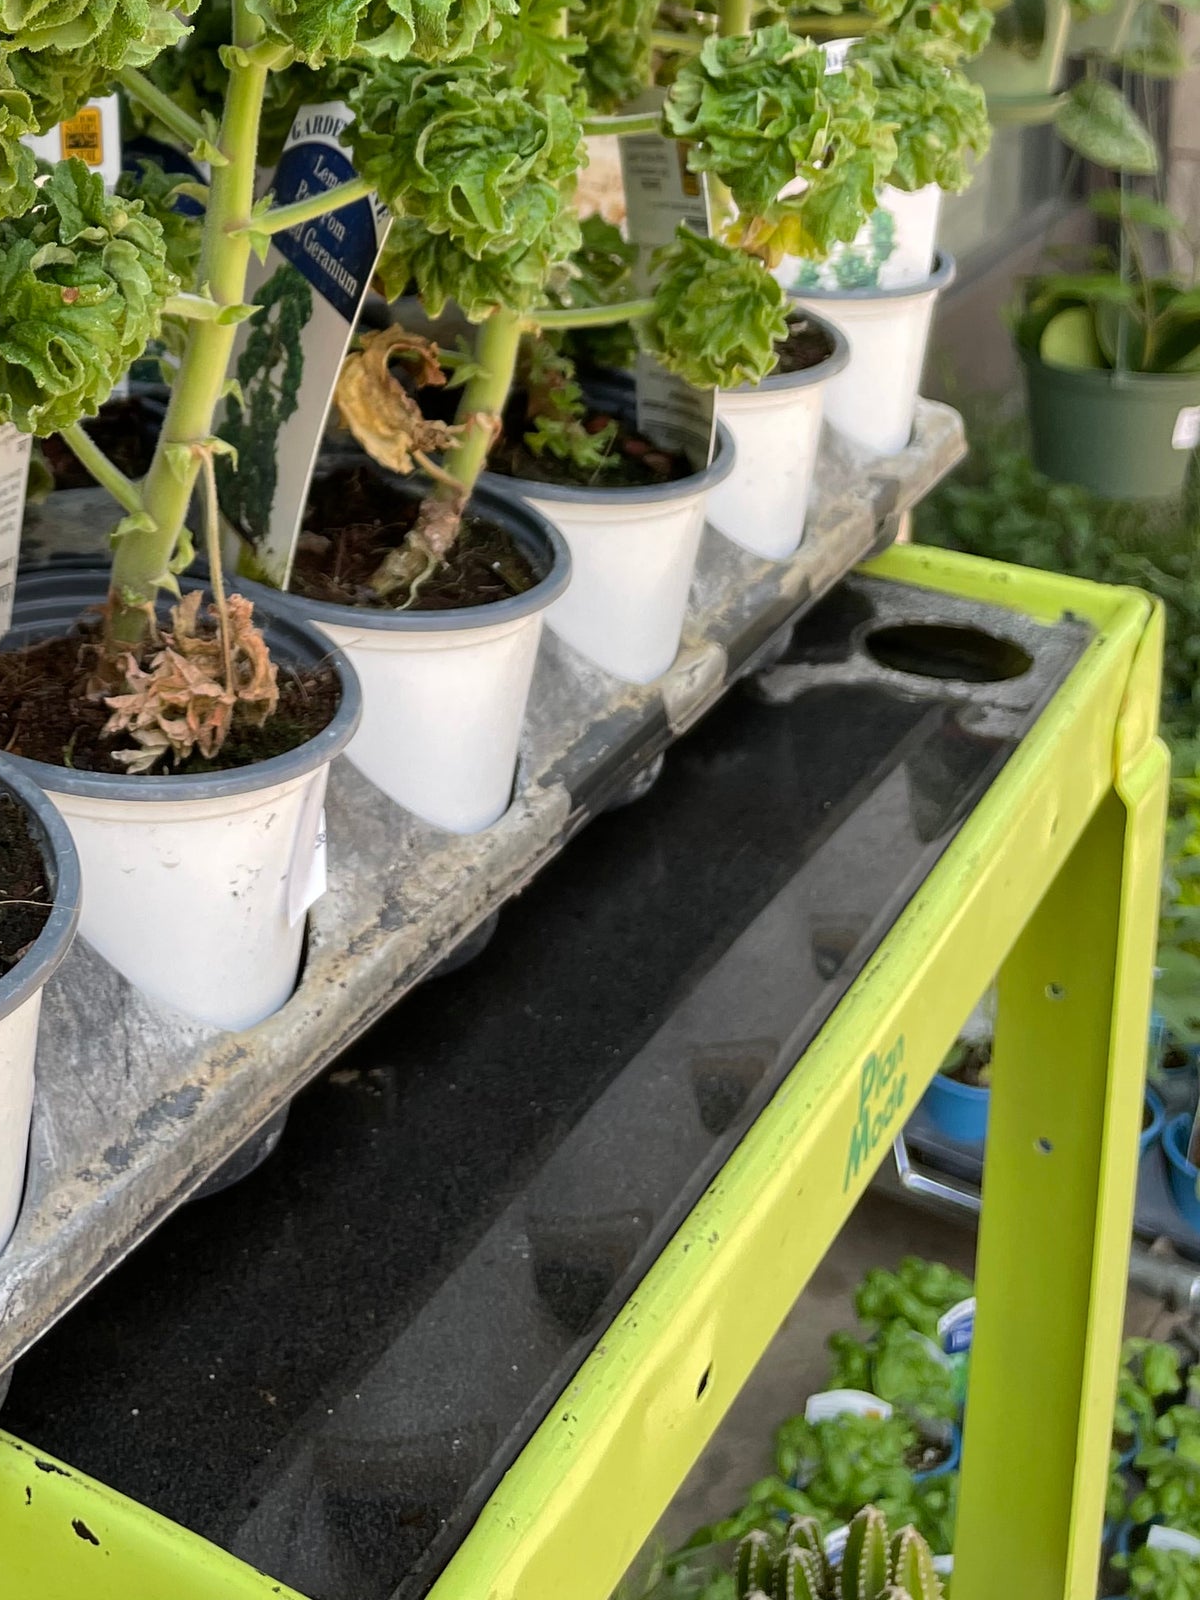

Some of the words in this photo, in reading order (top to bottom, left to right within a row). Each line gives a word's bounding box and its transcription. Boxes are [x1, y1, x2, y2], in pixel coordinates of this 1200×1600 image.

[291, 115, 347, 140] GARDE
[312, 154, 343, 189] Lem
[303, 226, 358, 298] Geranium
